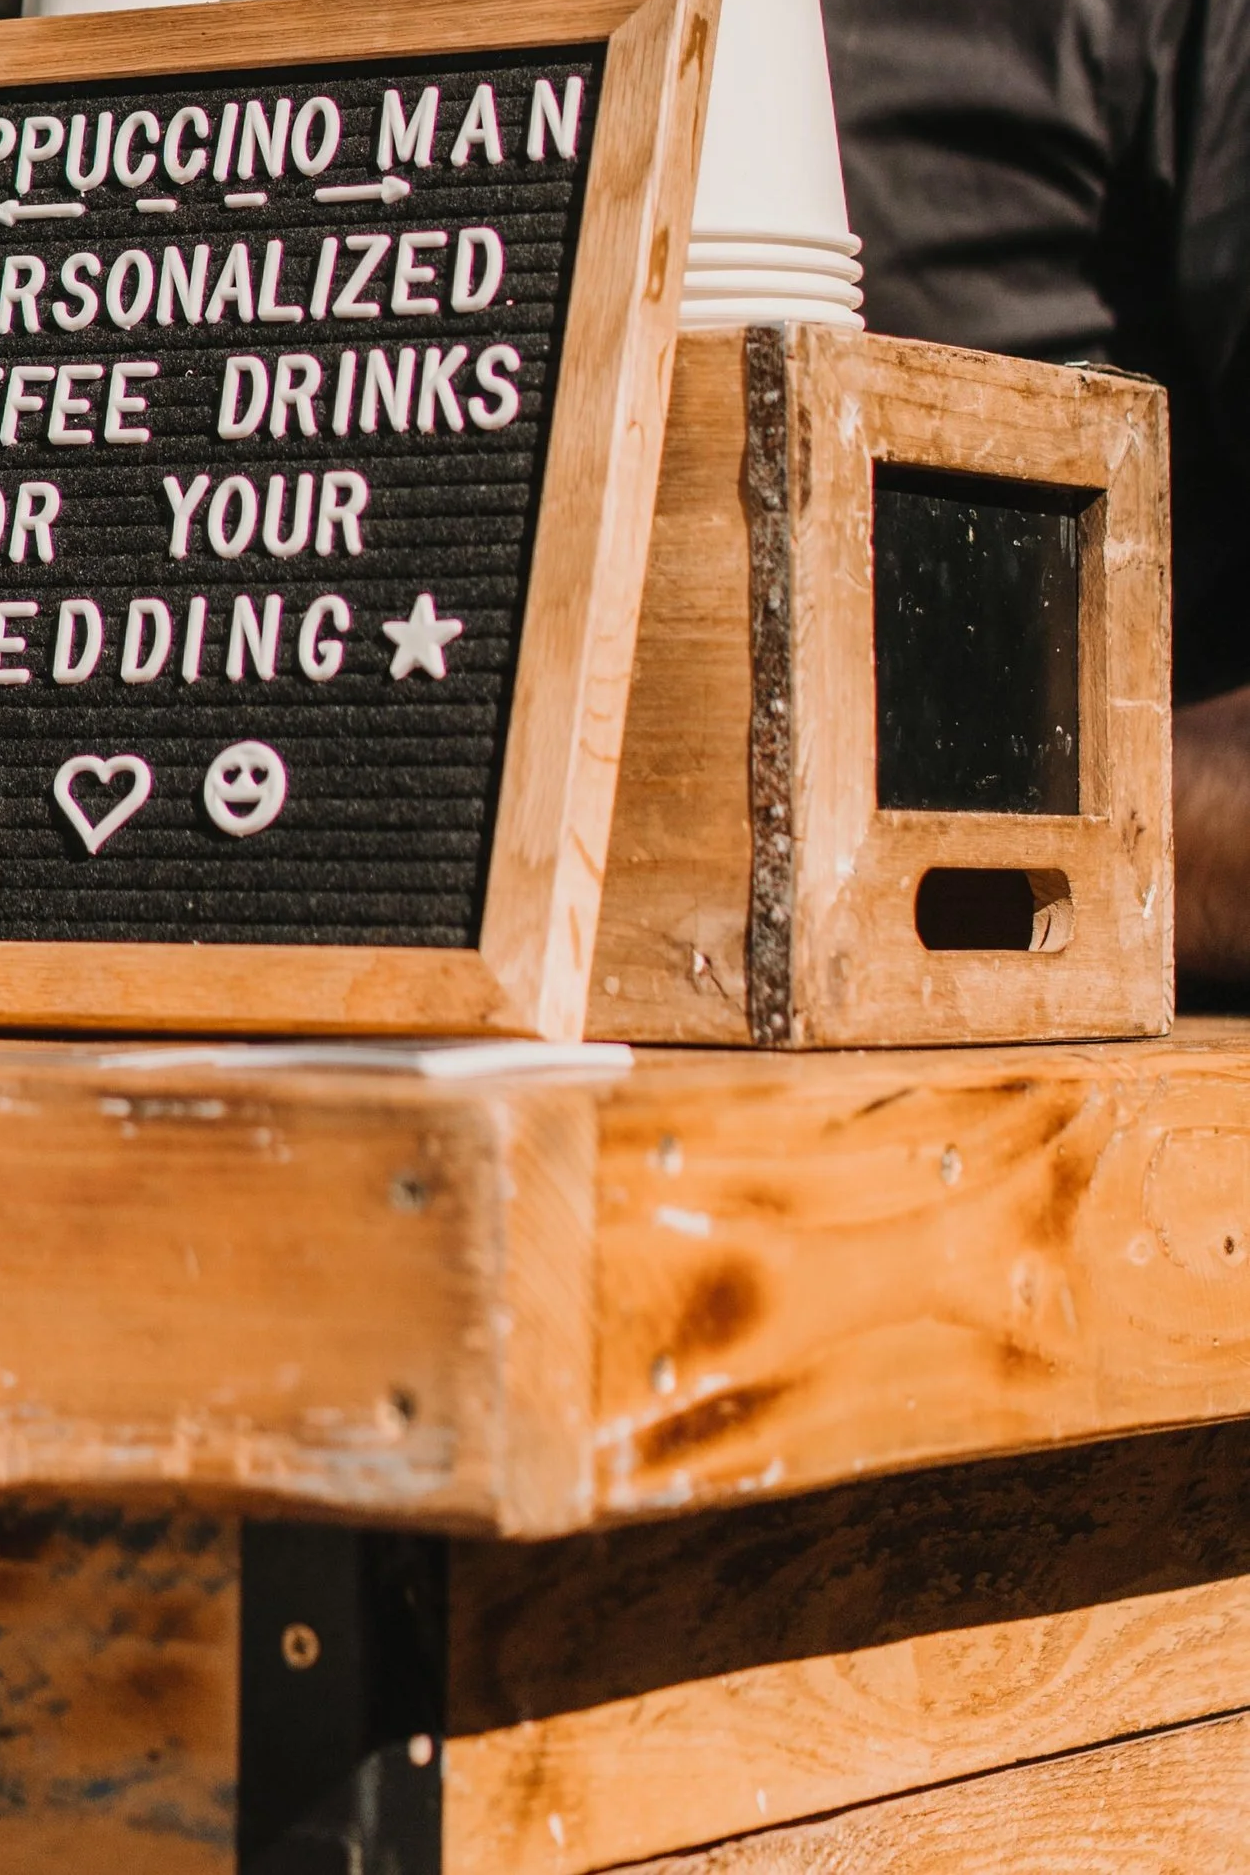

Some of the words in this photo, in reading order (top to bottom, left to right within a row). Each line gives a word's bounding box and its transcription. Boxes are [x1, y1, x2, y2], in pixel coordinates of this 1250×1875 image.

[376, 75, 584, 172] MAN
[217, 344, 521, 439] DRINKS
[162, 470, 369, 561] YOUR
